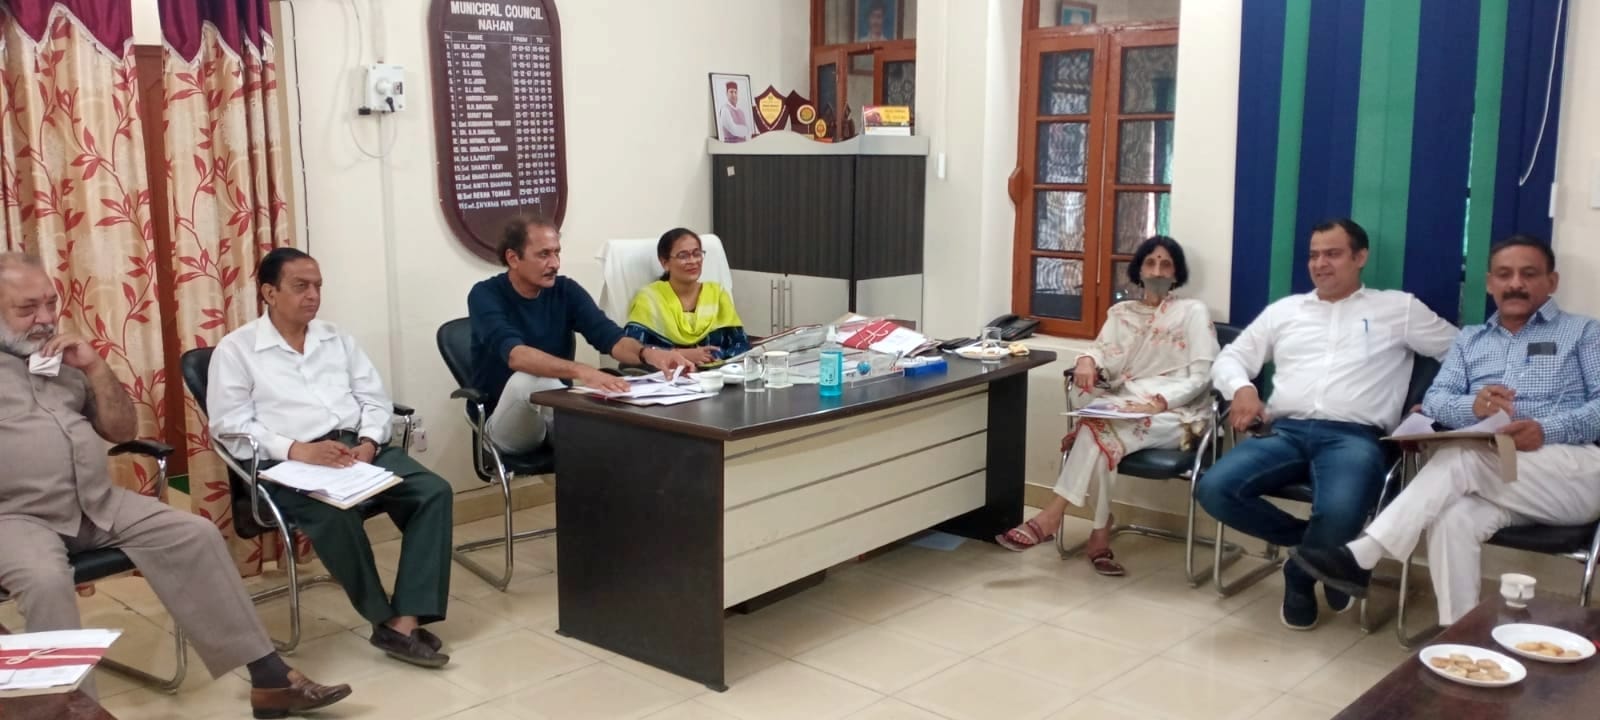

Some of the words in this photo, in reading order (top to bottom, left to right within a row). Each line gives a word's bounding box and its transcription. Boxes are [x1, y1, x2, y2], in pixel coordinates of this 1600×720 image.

[450, 1, 502, 16] MUNICIPAL
[505, 5, 544, 20] COUNCIL
[478, 19, 514, 32] NAHAN
